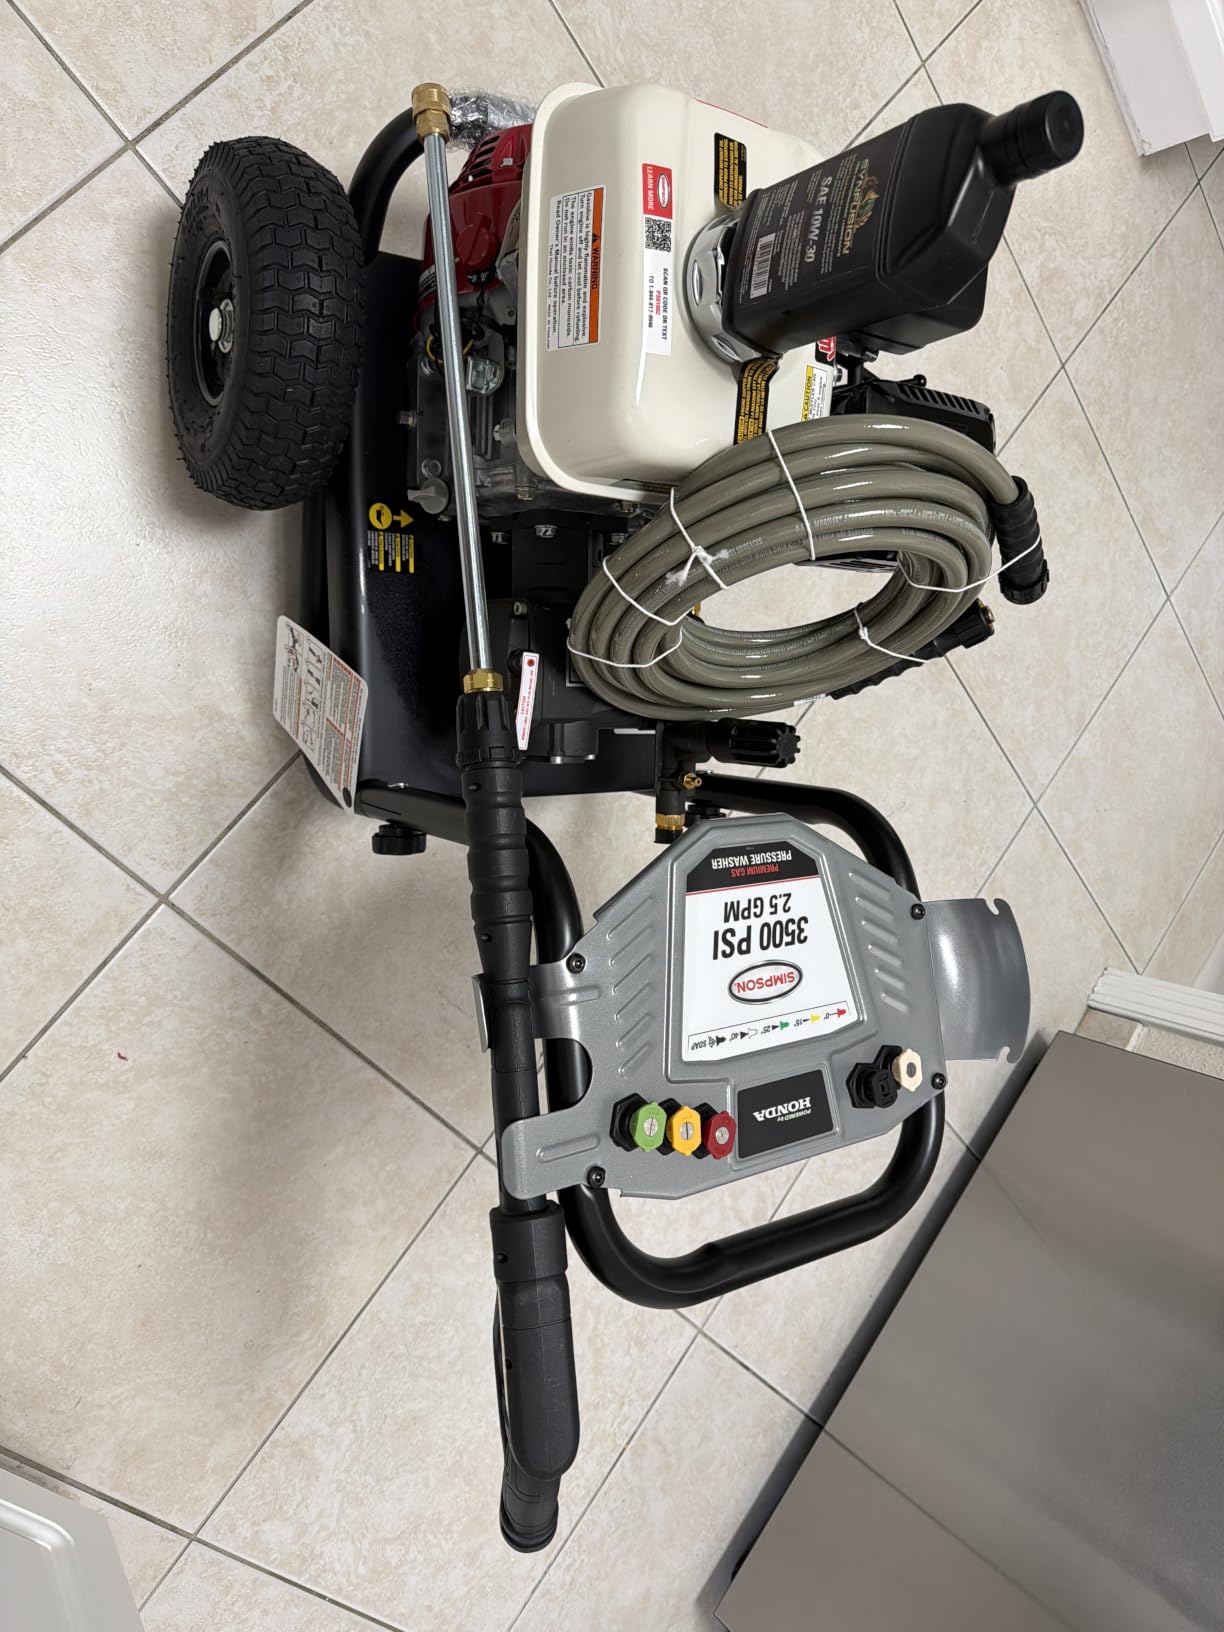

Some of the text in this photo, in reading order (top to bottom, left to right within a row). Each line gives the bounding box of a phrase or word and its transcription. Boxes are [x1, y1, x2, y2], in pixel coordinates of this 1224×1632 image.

[815, 176, 833, 206] SAE
[564, 197, 570, 207] Do
[842, 159, 869, 254] SYNFUSION
[804, 207, 824, 263] 10W-30
[562, 245, 567, 254] an
[592, 248, 600, 290] WARNING
[648, 275, 654, 284] TO
[803, 376, 811, 411] CAUTION
[711, 850, 792, 869] PRESSURE WASHER
[730, 864, 779, 878] PREMIUM GAS
[723, 893, 792, 923] 2.5 GPM
[712, 916, 809, 961] 3500 PSI
[761, 1025, 771, 1034] 25°
[793, 1018, 803, 1027] 15°
[691, 1040, 707, 1050] SOAP
[753, 1097, 812, 1121] HONDA
[784, 1109, 812, 1121] POWERED
